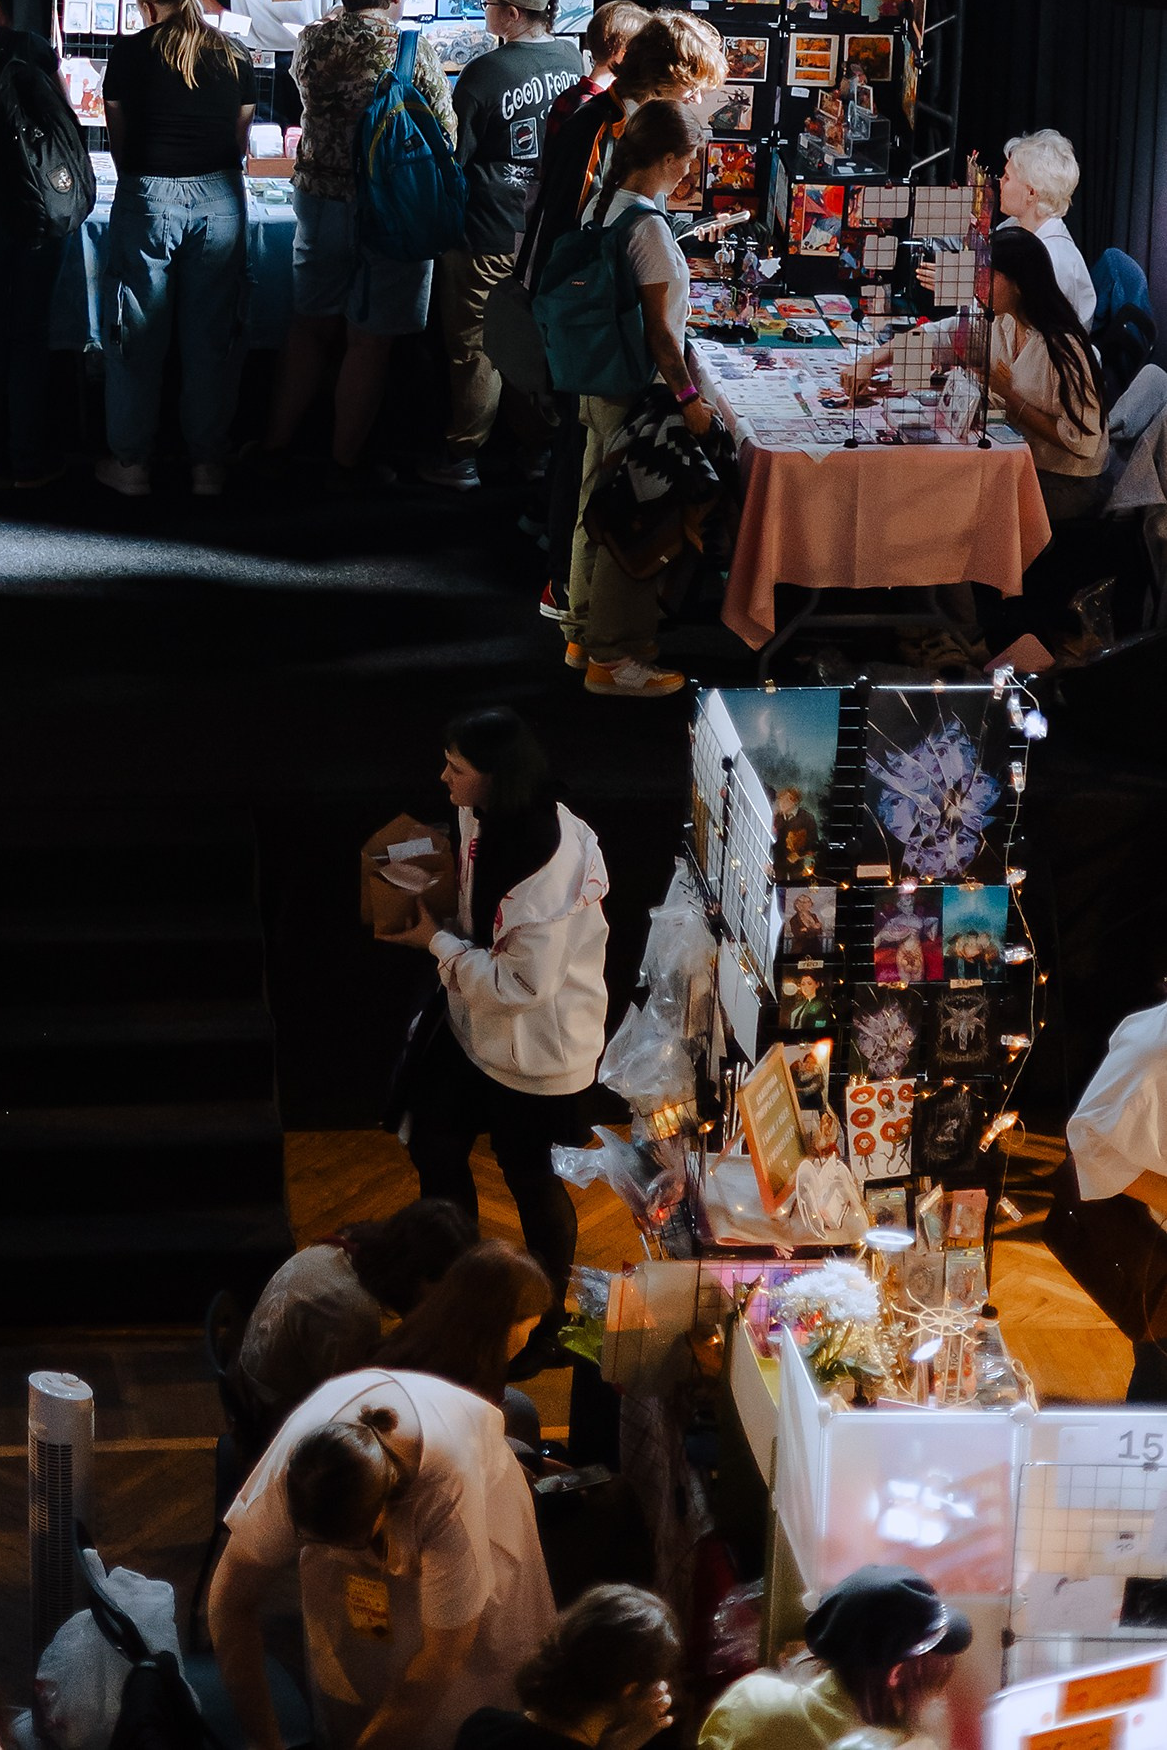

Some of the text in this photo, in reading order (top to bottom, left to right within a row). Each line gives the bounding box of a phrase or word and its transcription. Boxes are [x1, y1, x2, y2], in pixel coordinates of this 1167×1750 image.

[502, 70, 580, 121] GOOD FORT
[1118, 1430, 1164, 1461] 15
